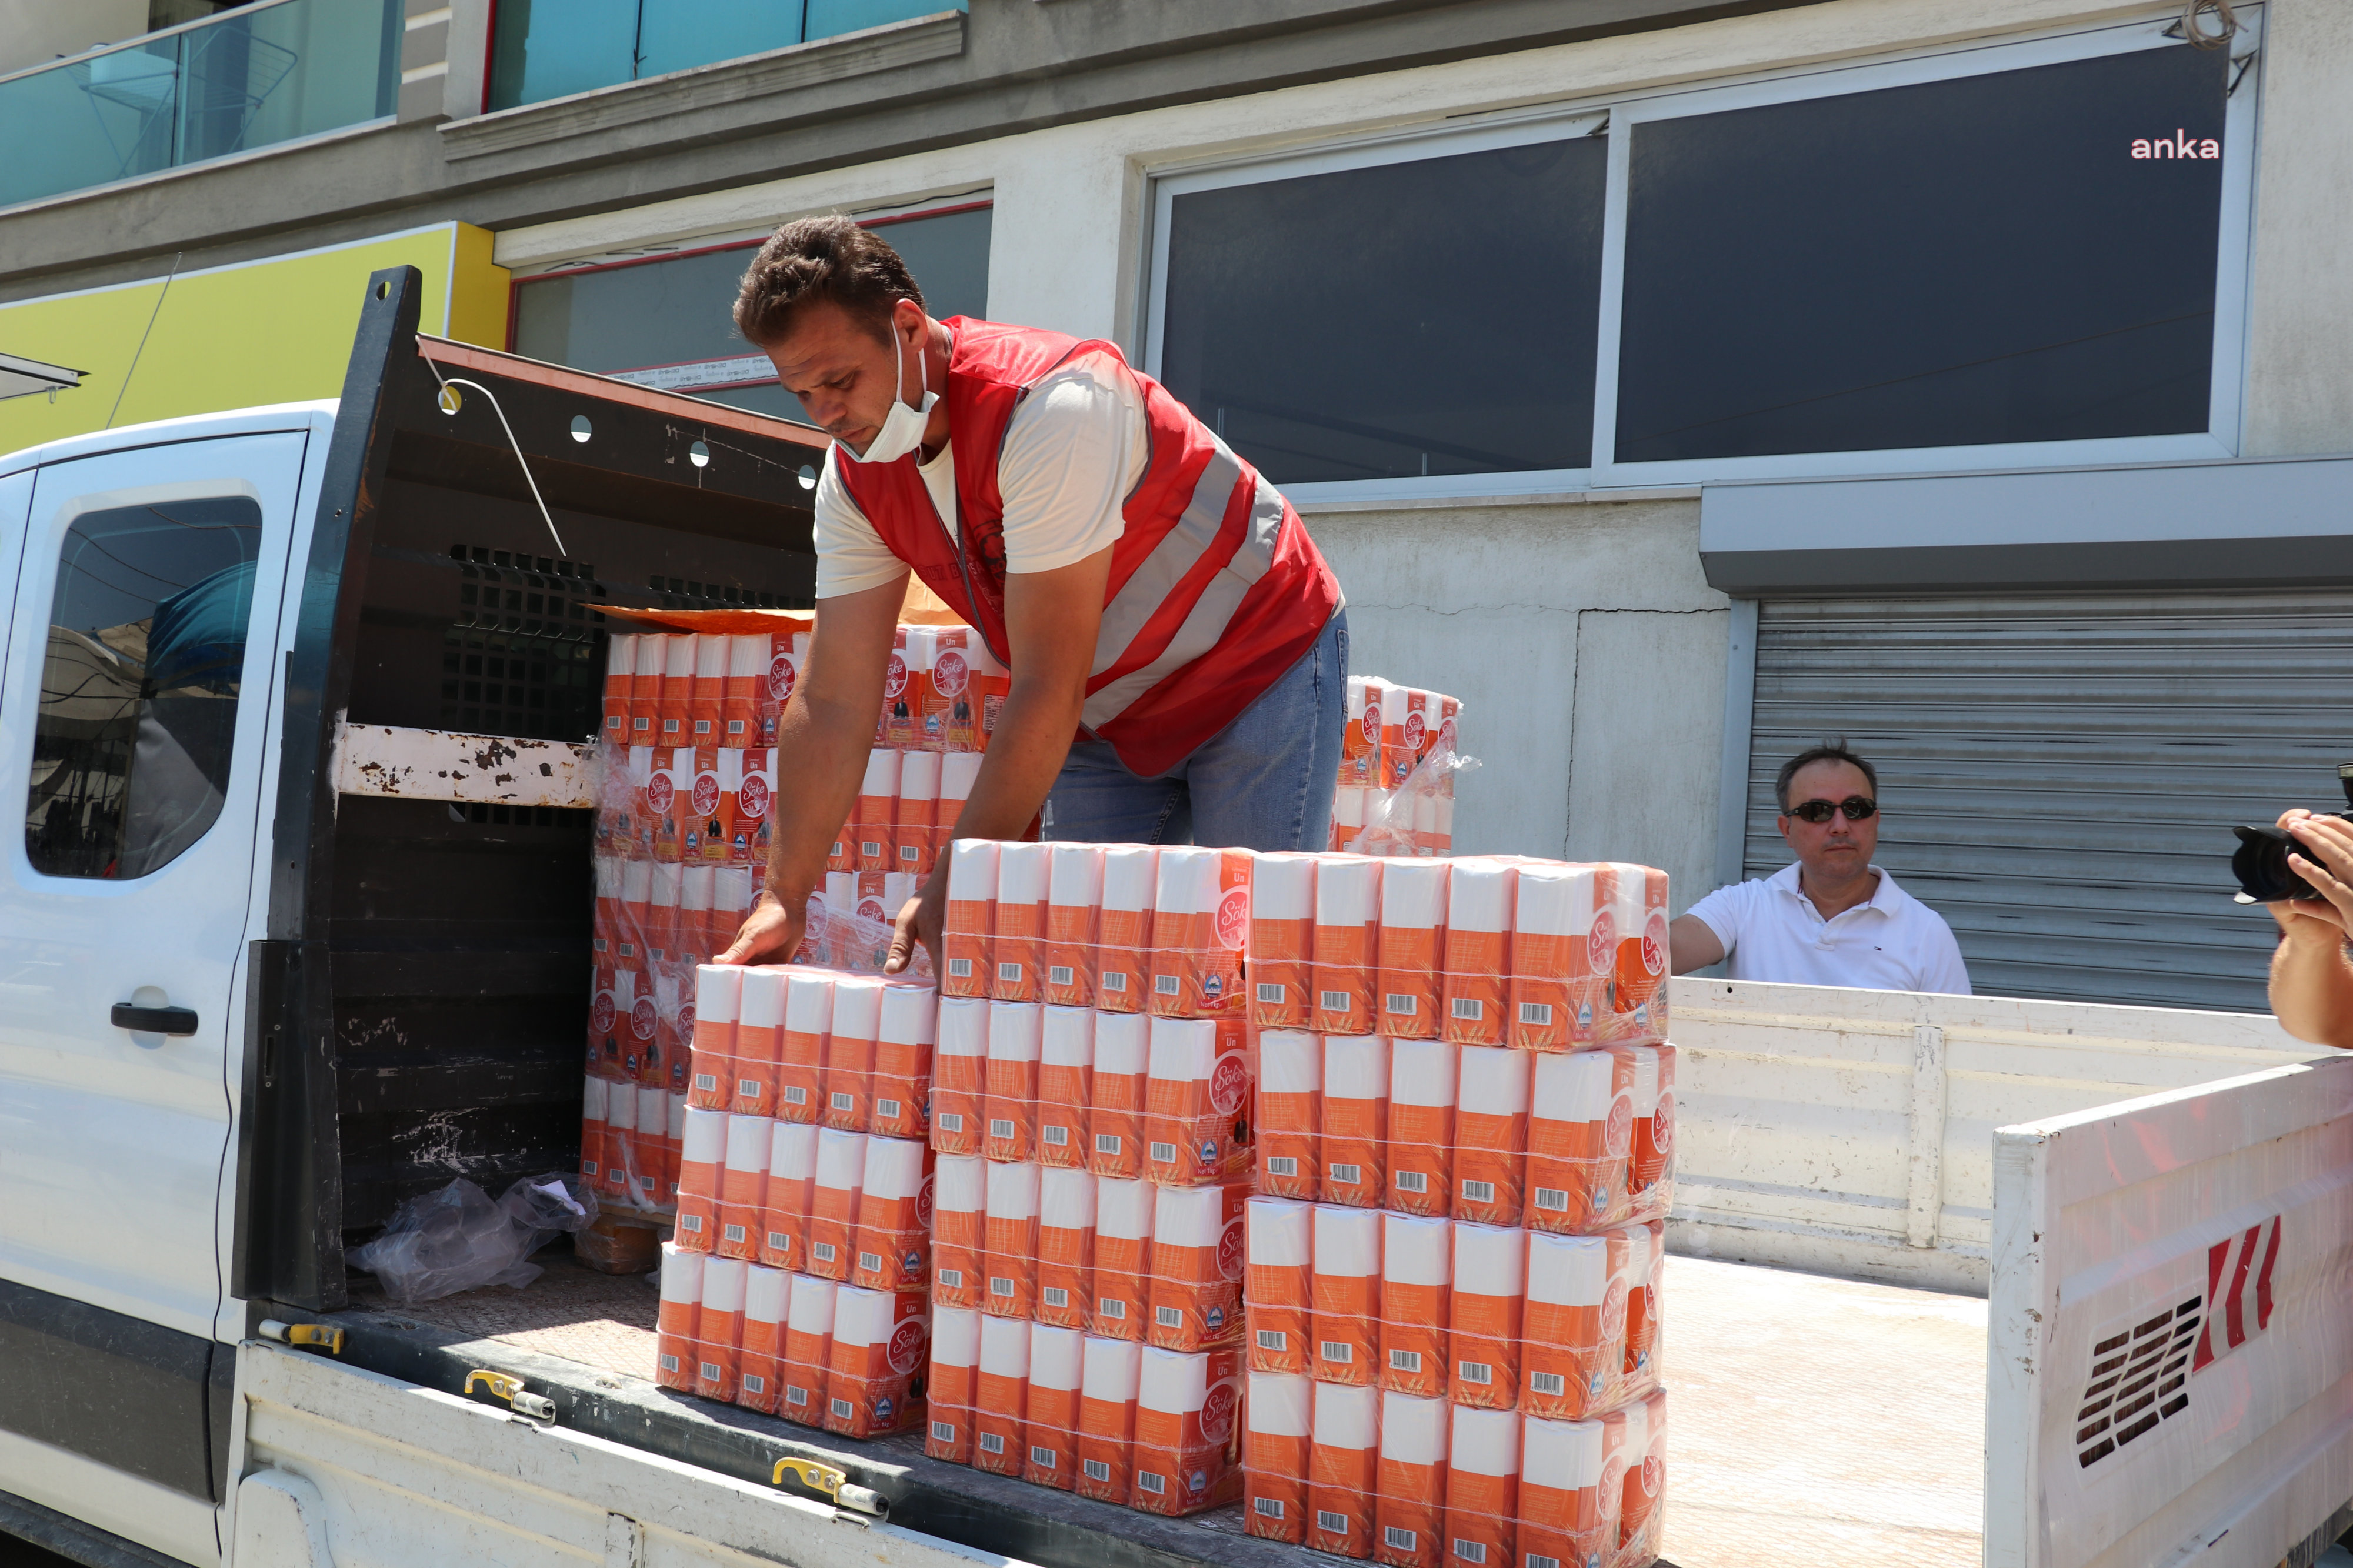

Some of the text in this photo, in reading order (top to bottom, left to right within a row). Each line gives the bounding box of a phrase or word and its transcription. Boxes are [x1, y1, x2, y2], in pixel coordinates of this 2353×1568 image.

[772, 664, 791, 683] Söke
[888, 660, 902, 675] öke
[937, 659, 964, 679] Söke
[1407, 719, 1423, 733] Söke
[651, 779, 670, 796] Söke
[696, 781, 716, 799] Söke
[743, 782, 765, 800] Söke
[1234, 873, 1244, 882] Un
[1653, 894, 1659, 903] Un
[596, 999, 612, 1015] Söke
[680, 1013, 694, 1029] Sök
[1227, 1037, 1236, 1046] Un
[1621, 1074, 1628, 1084] Un
[1234, 1203, 1243, 1212] Un
[906, 1305, 916, 1313] Un
[893, 1328, 922, 1353] Söke
[1218, 1366, 1228, 1376] Un
[1206, 1392, 1234, 1420] Söke
[1612, 1436, 1619, 1446] Un
